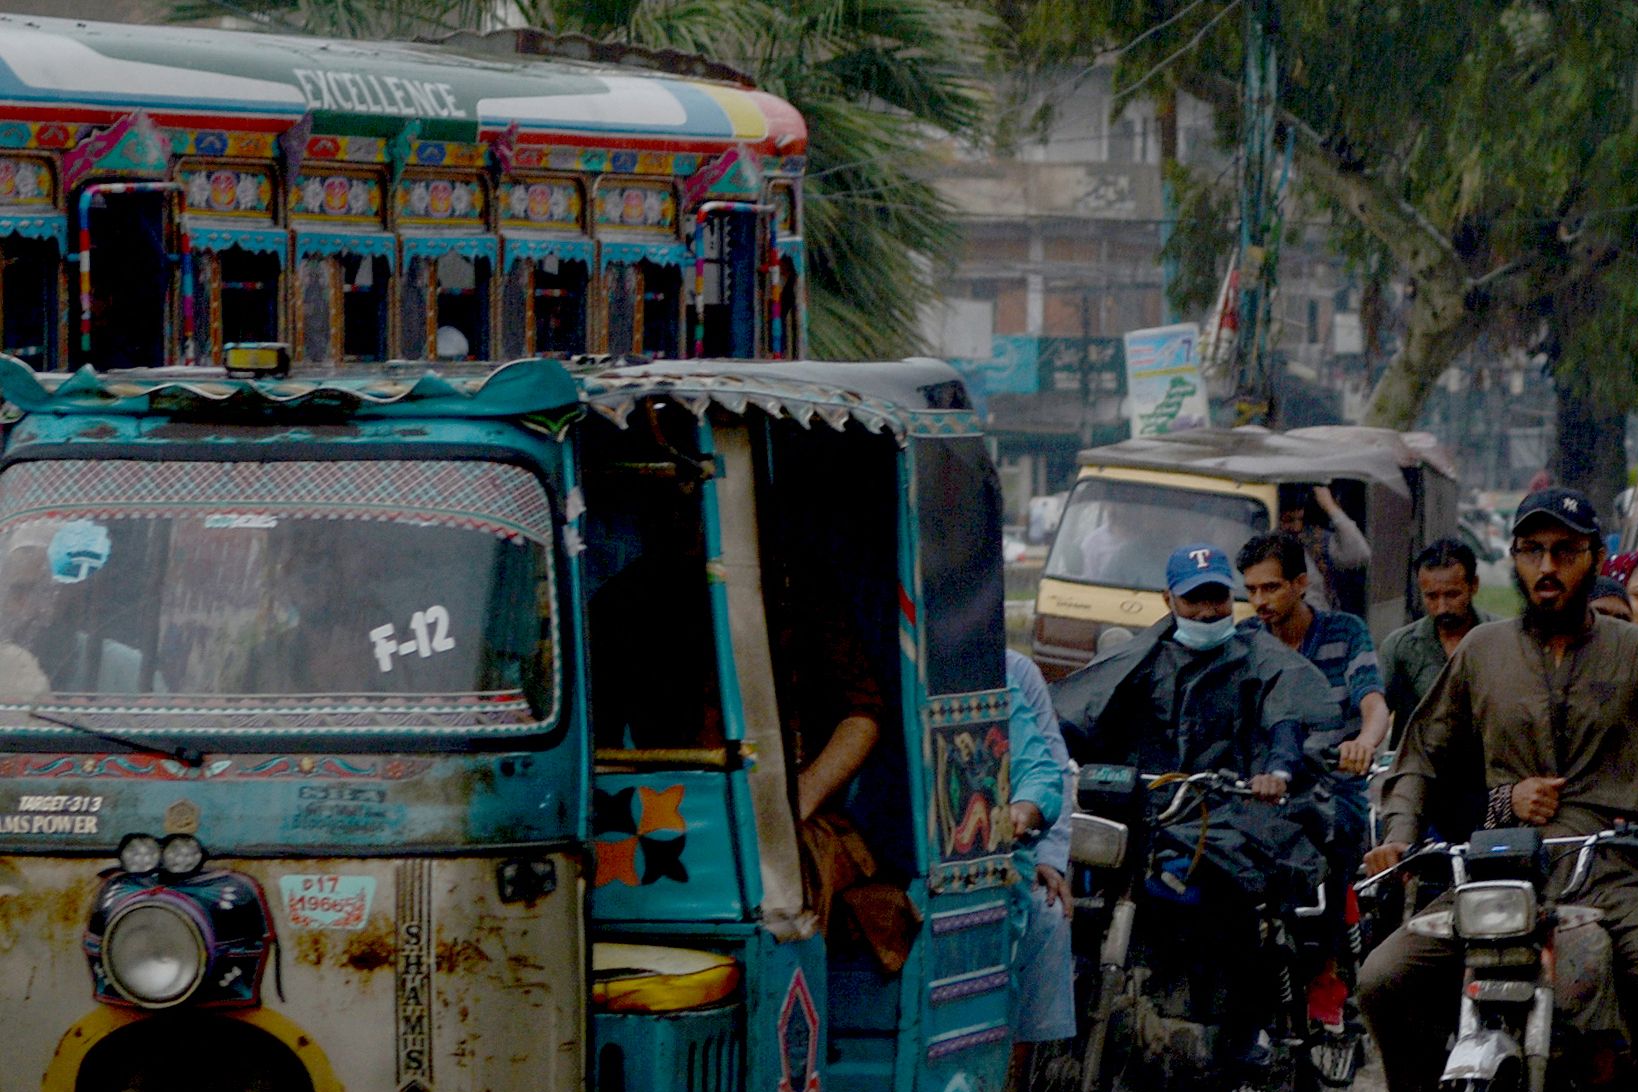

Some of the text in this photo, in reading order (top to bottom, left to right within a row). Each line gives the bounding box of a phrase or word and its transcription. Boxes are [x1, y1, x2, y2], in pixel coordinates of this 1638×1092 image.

[293, 68, 466, 118] EXCELLENCE
[1188, 548, 1211, 569] T
[368, 604, 456, 673] F-12
[18, 795, 104, 812] TARGET-313
[31, 815, 99, 833] POWER
[402, 923, 424, 1071] SHAMS
